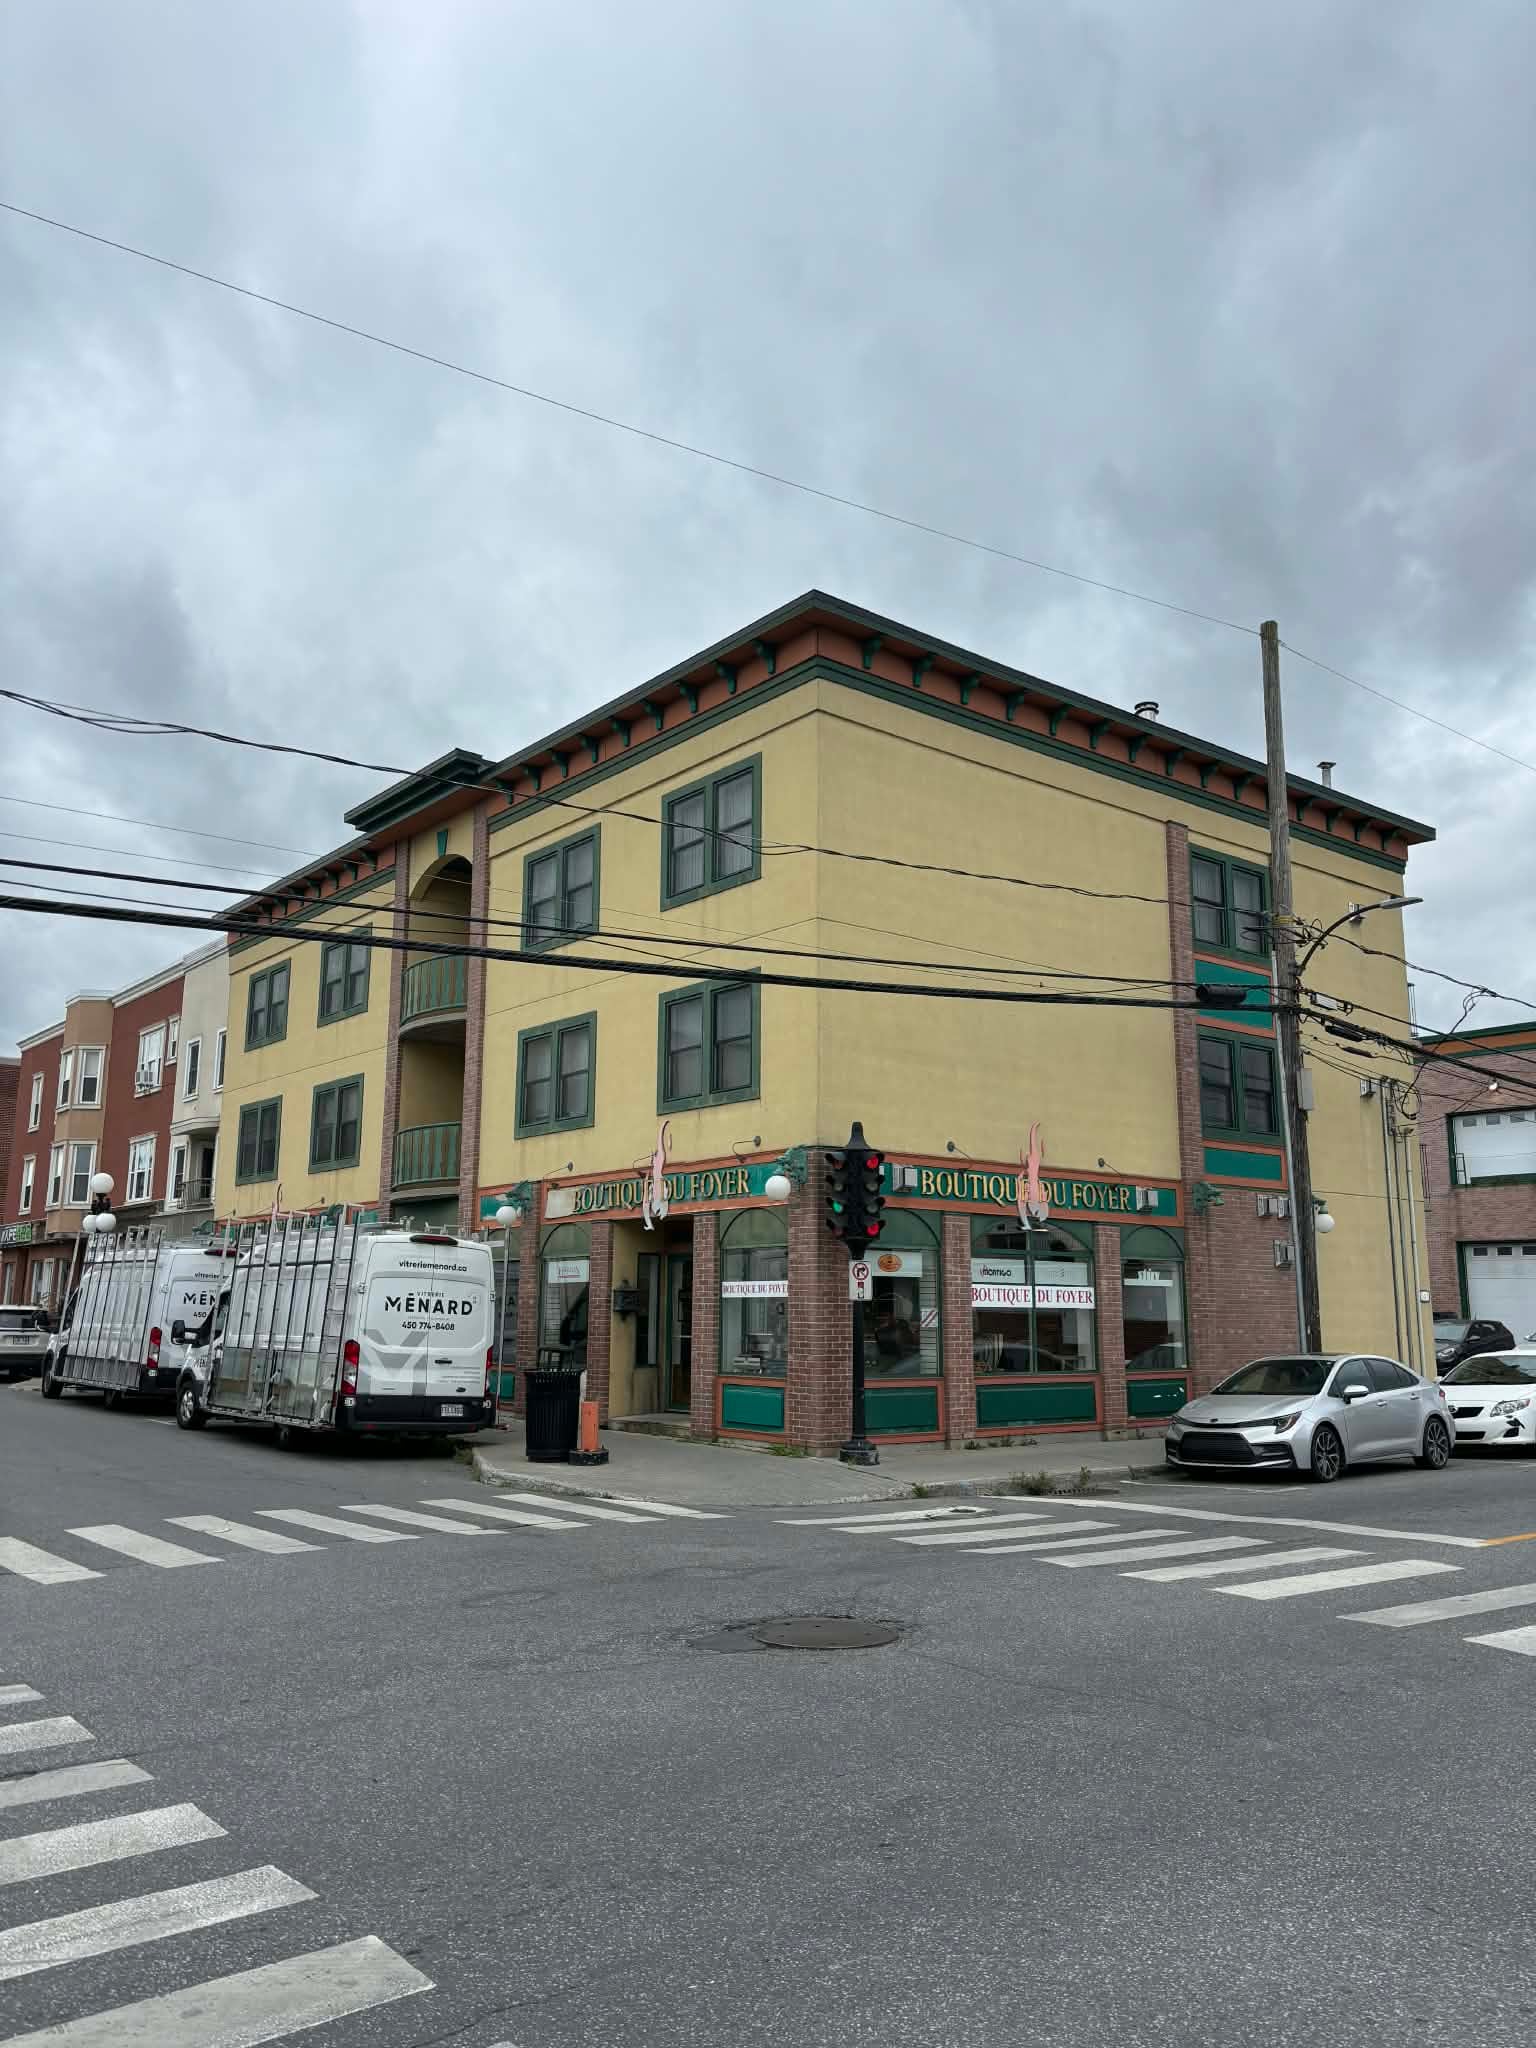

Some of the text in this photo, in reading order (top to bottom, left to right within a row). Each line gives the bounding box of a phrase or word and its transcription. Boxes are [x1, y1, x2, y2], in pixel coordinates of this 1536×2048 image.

[574, 1169, 750, 1212] BOUTIQUE DU FOYER
[922, 1169, 1132, 1212] BOUTIQUE DU FOYER
[399, 1260, 467, 1272] vitreriemenard.ca
[972, 1287, 1093, 1305] BOUTIQUE DU FOYER
[401, 1321, 417, 1329] 450
